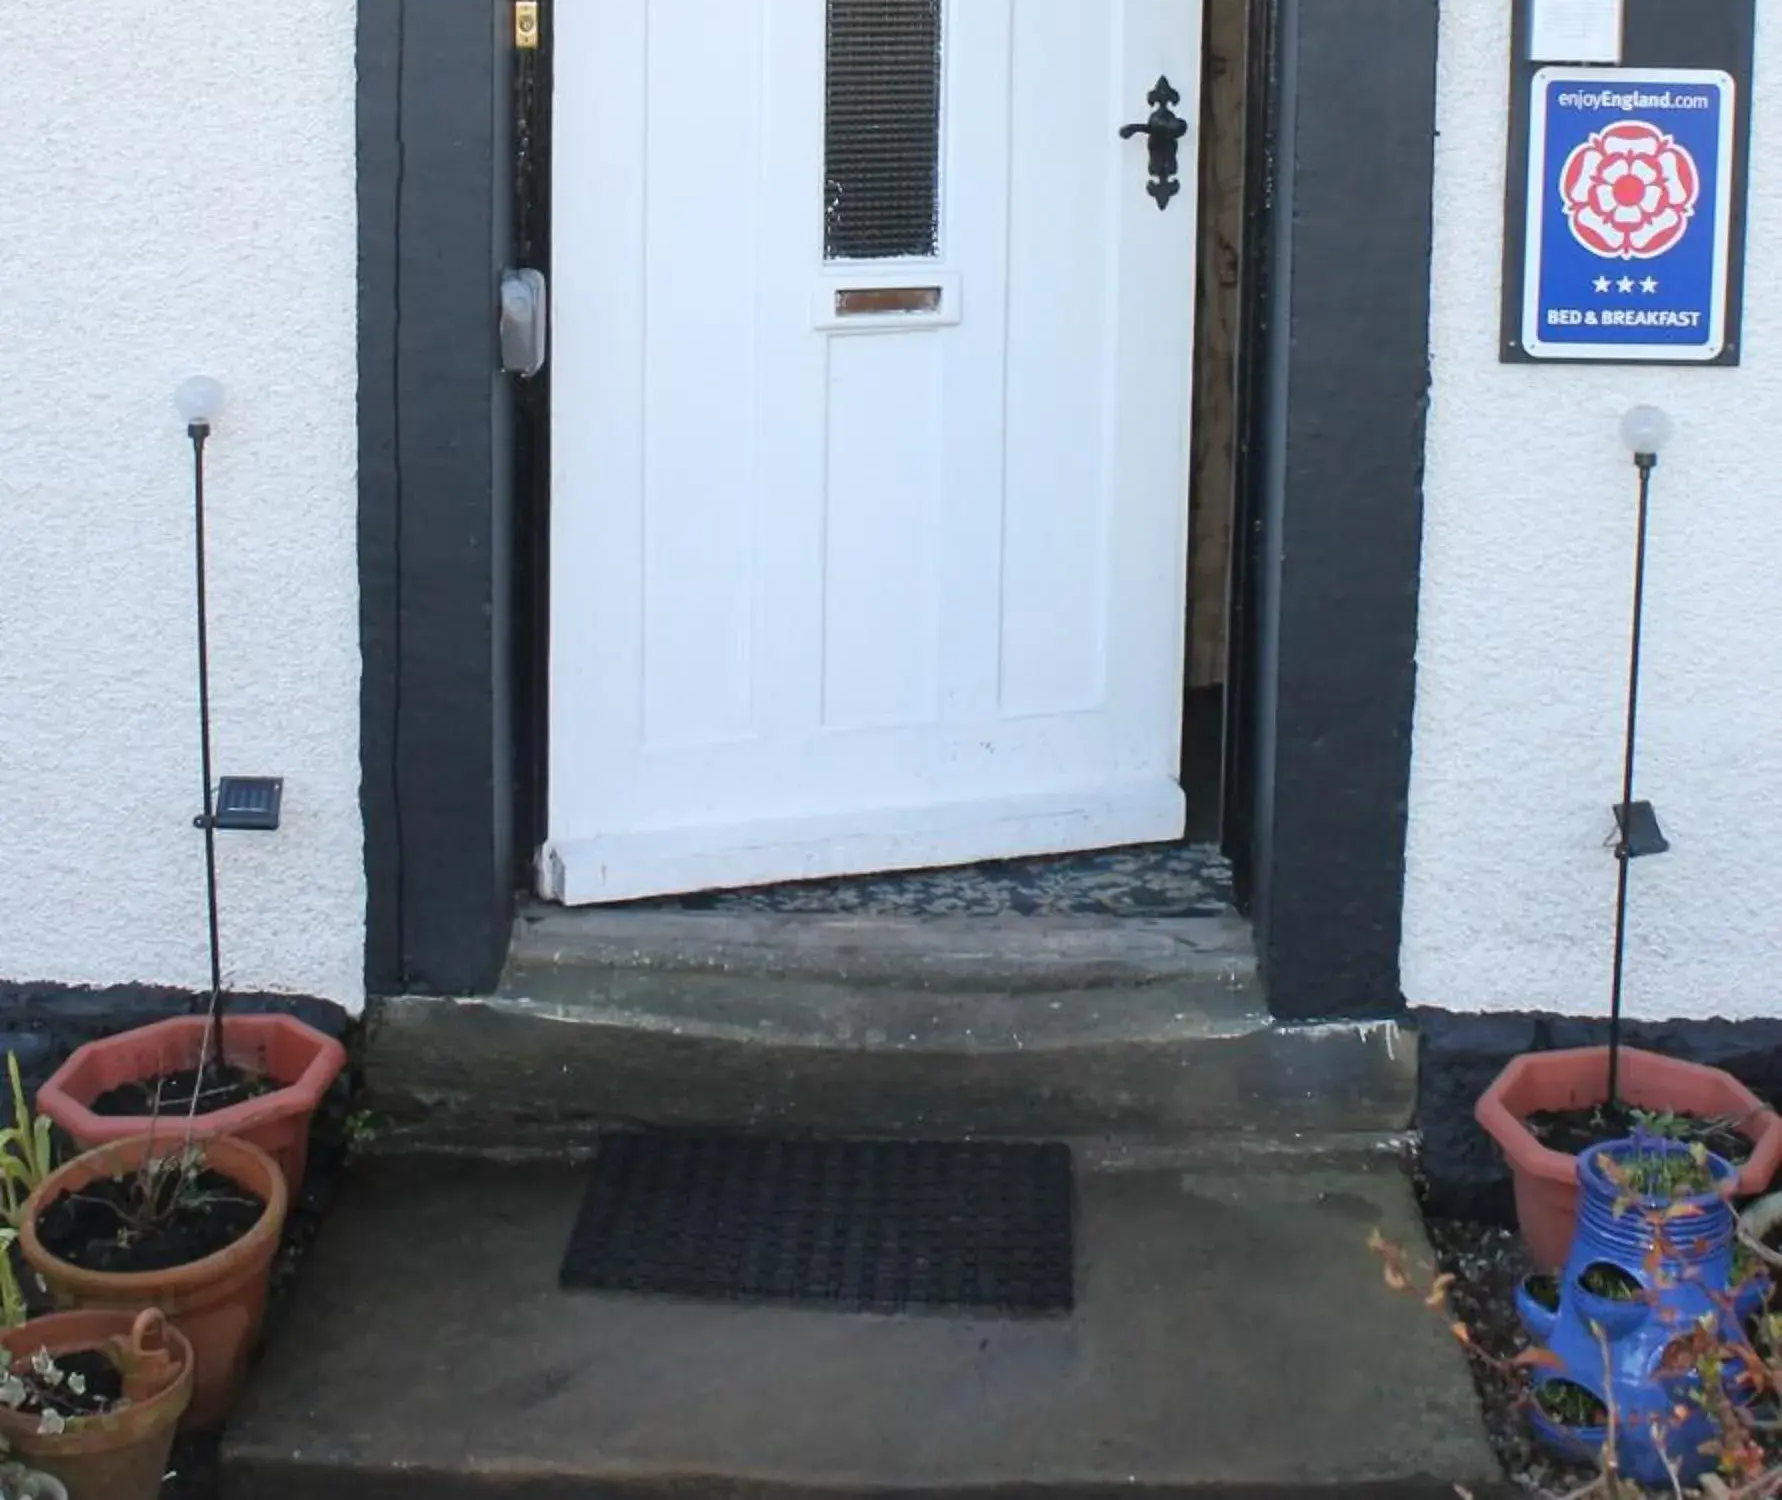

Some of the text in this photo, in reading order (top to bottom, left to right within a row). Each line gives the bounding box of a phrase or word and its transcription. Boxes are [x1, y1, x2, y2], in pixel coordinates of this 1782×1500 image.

[1558, 90, 1708, 111] enjoyEngland.com
[1546, 309, 1701, 328] BED & BREAKFAST
